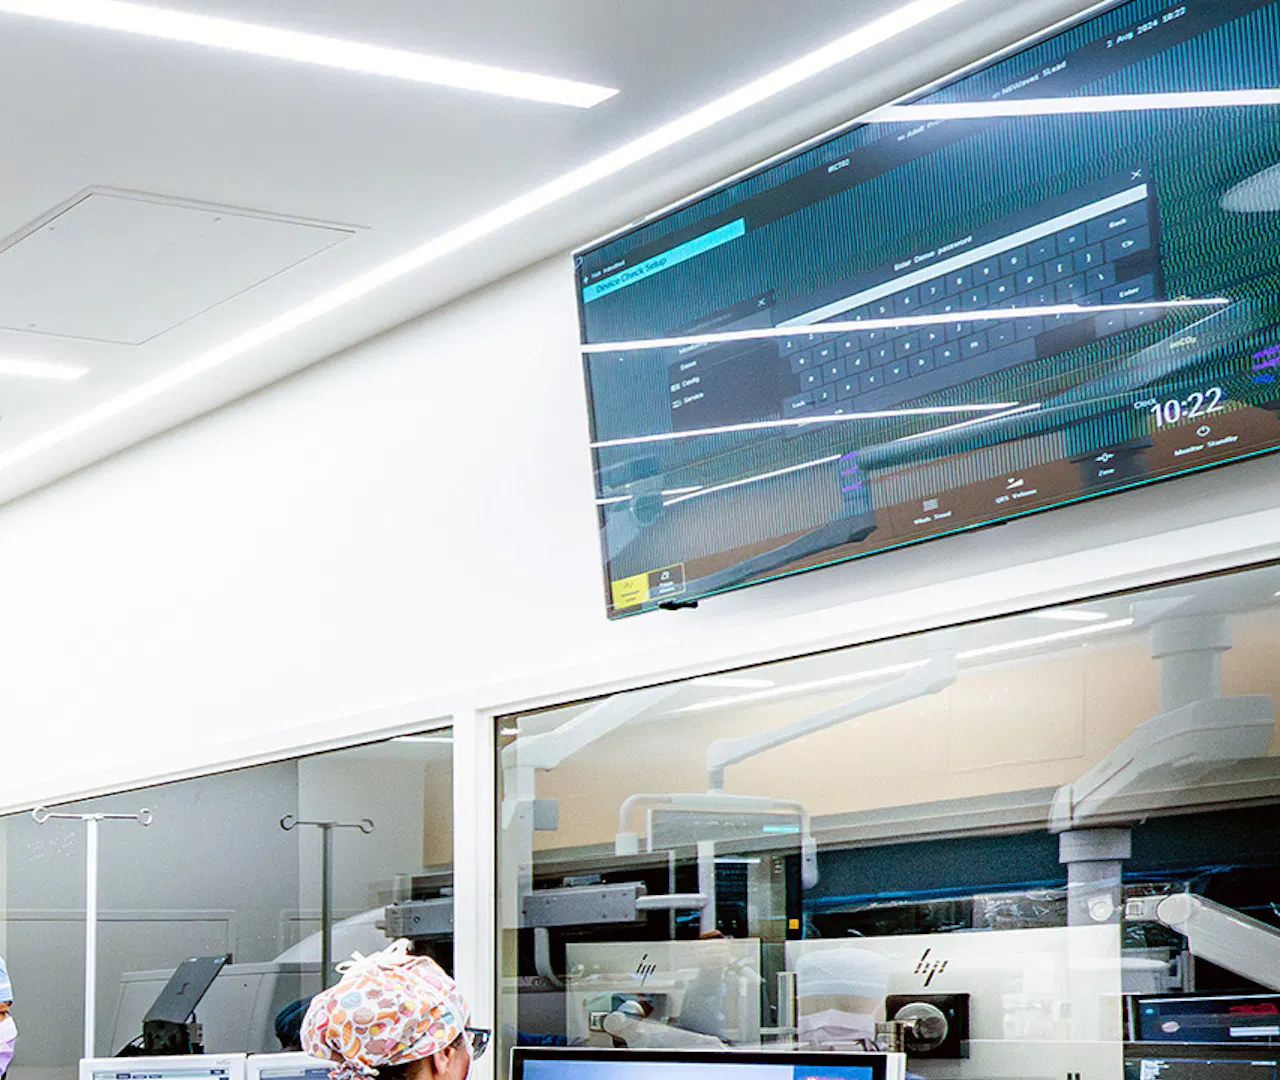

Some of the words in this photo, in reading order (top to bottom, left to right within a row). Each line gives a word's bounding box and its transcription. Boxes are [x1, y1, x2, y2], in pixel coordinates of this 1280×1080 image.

[1116, 31, 1134, 45] Aug
[1136, 19, 1158, 35] 2024
[937, 235, 973, 256] password
[621, 267, 644, 283] Check
[645, 257, 668, 275] Setup
[1133, 398, 1157, 410] Clock
[1150, 387, 1224, 428] 10:22
